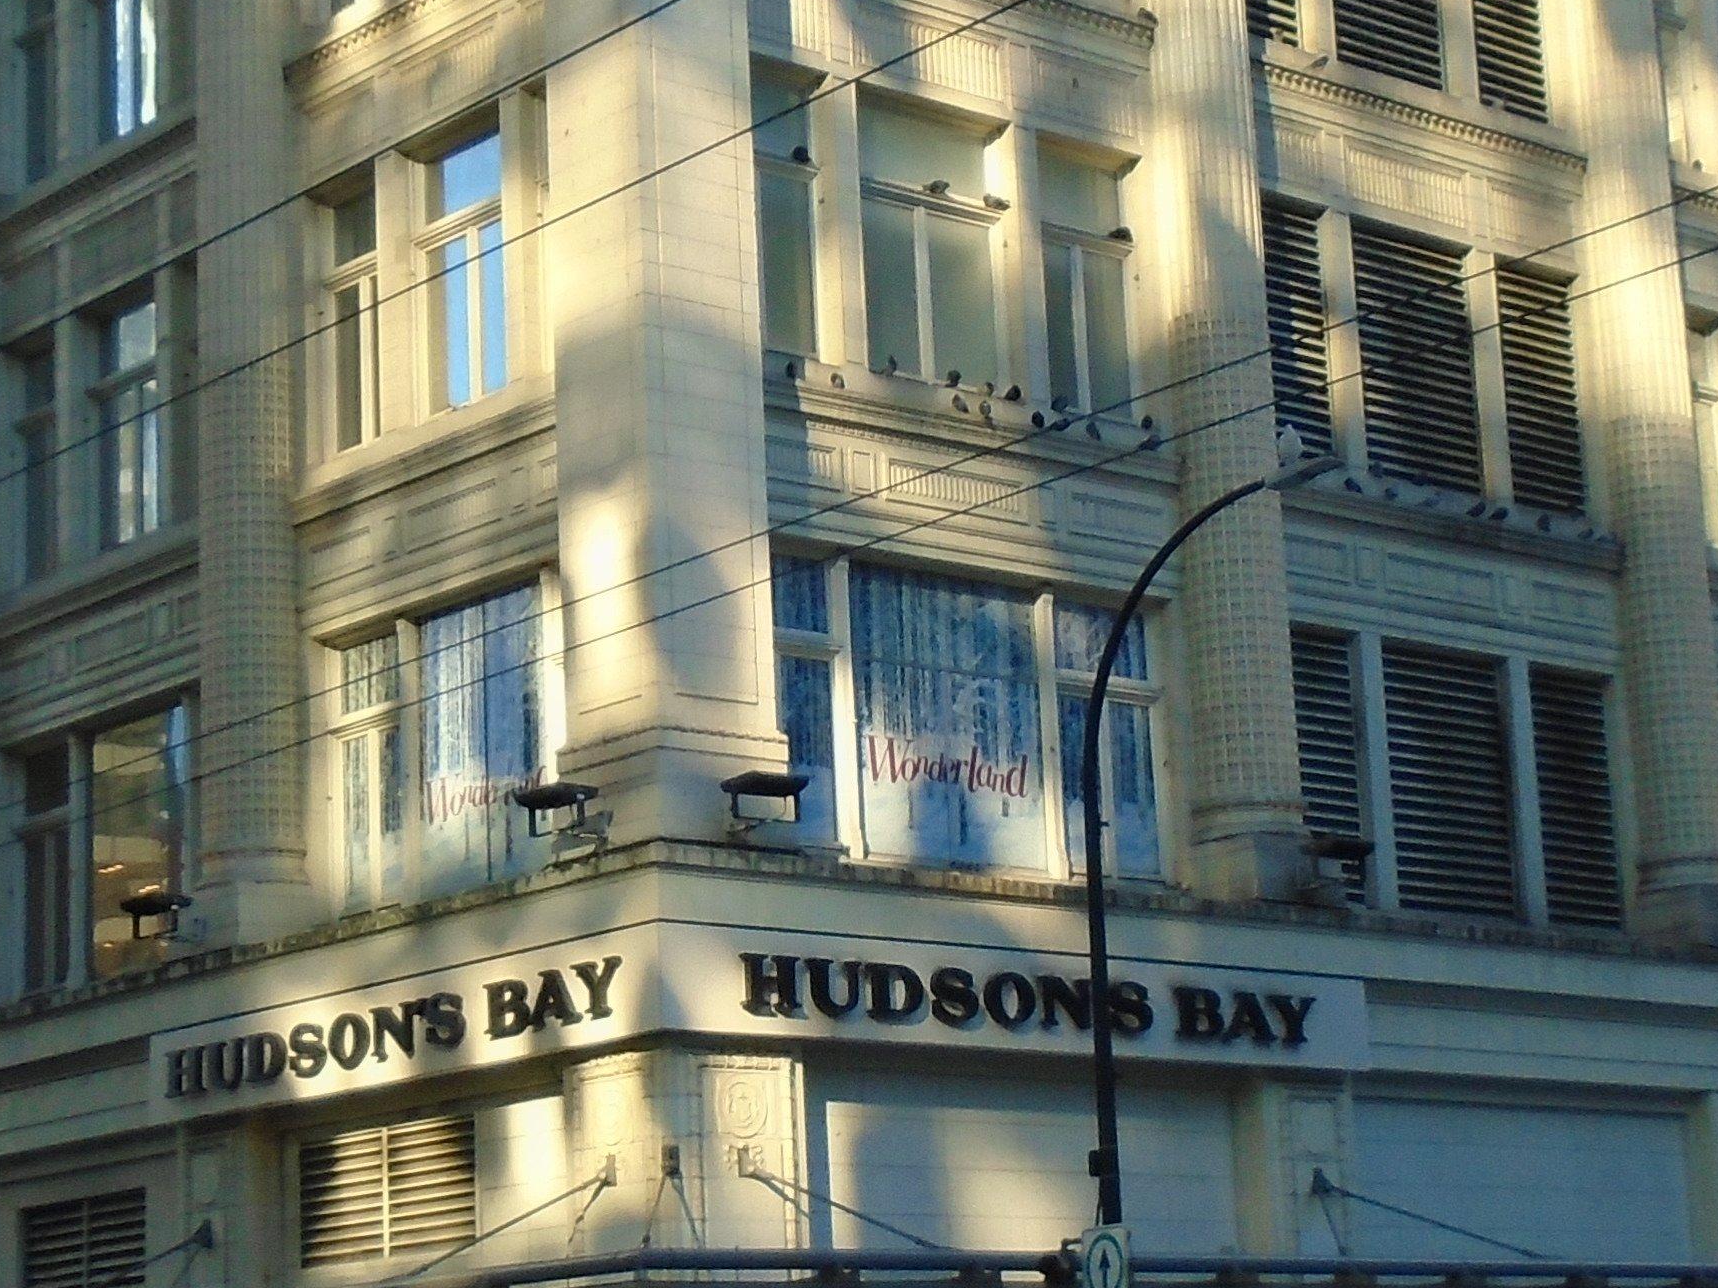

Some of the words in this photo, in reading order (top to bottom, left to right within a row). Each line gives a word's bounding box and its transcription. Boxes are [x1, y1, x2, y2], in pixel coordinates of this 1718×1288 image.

[868, 735, 1030, 799] Wonderland
[164, 991, 468, 1100] HUDSON'S
[482, 955, 624, 1041] BAY
[739, 952, 1155, 1036] HUDSONS
[1171, 984, 1317, 1047] BAY
